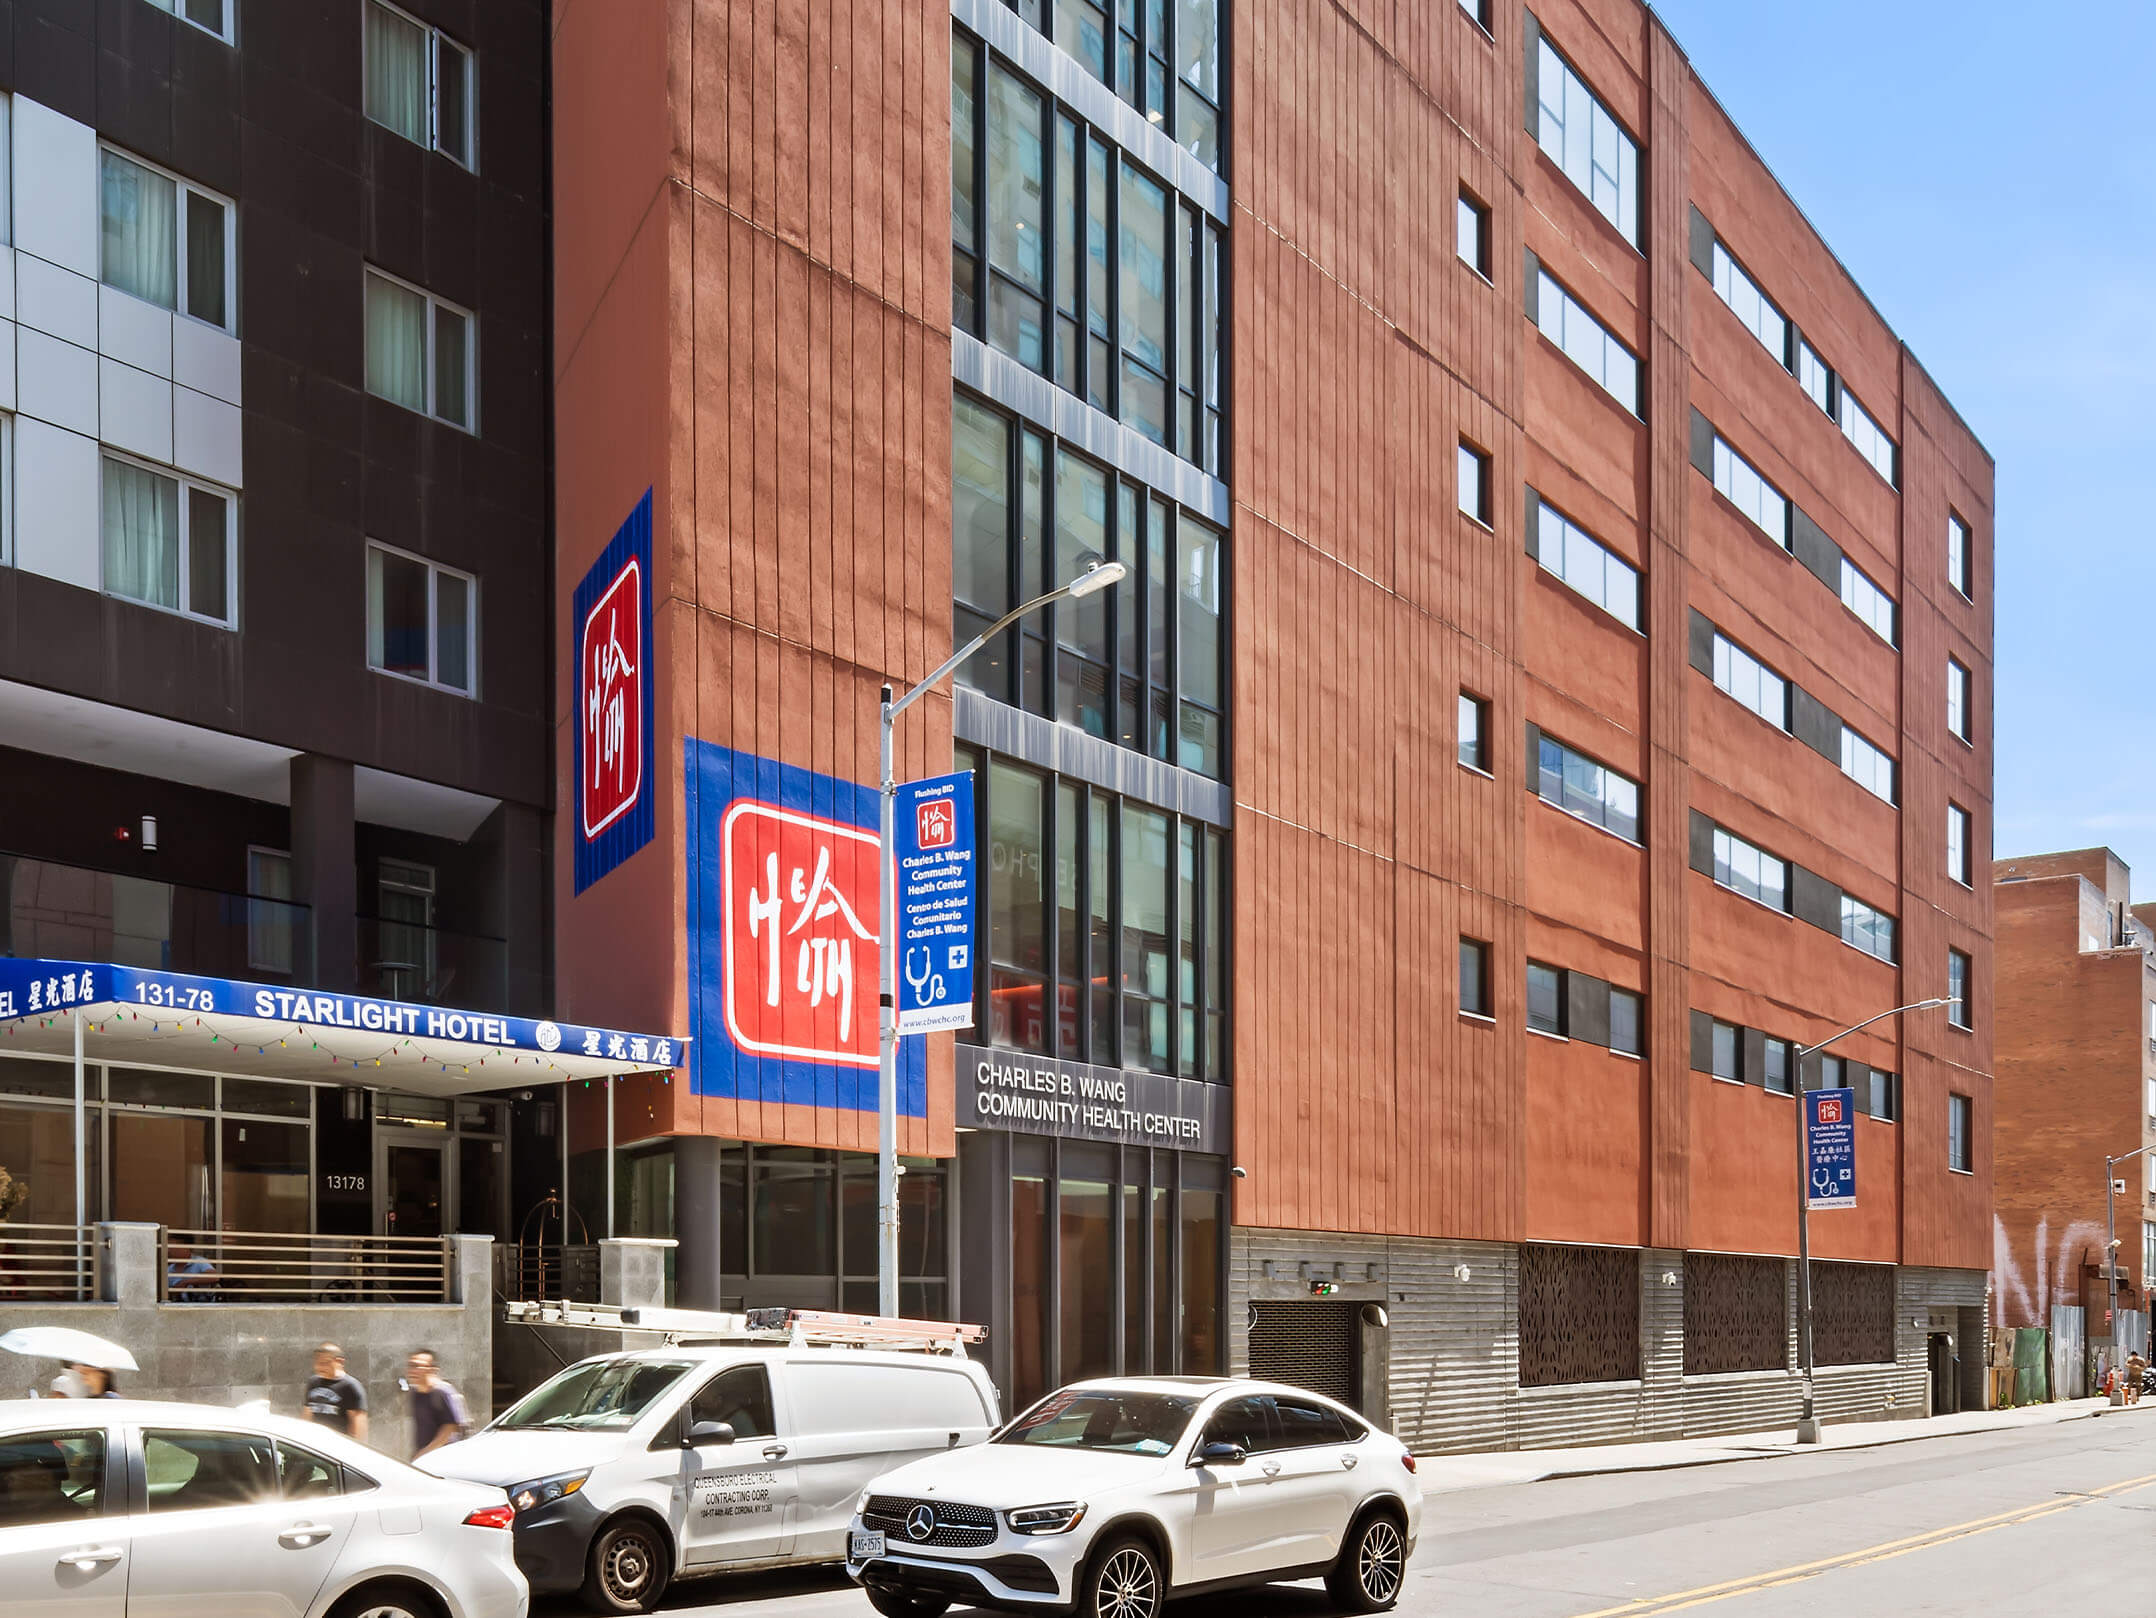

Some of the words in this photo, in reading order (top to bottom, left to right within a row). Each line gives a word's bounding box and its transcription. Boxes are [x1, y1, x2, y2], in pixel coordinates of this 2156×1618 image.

[902, 856, 934, 868] Charles
[935, 853, 944, 863] B.
[945, 850, 971, 861] Wang
[912, 865, 962, 881] Community
[907, 883, 935, 896] Health
[936, 879, 966, 891] Center
[906, 903, 931, 914] Centro
[932, 899, 943, 910] de
[944, 896, 968, 908] Salud
[912, 911, 962, 926] Comunitario
[906, 927, 934, 939] Charles
[935, 925, 944, 934] B.
[944, 923, 968, 934] Wang
[28, 969, 94, 1012] 星光酒店
[135, 981, 215, 1012] 131-78
[254, 990, 420, 1034] STARLIGHT
[427, 1011, 516, 1046] HOTEL
[582, 1030, 671, 1065] 星光酒店
[977, 1062, 1056, 1094] CHARLES
[1060, 1075, 1075, 1096] B.
[1079, 1077, 1126, 1103] WANG
[977, 1091, 1079, 1124] COMMUNITY
[1083, 1107, 1141, 1131] HEALTH
[1144, 1112, 1201, 1139] CENTER
[327, 1175, 365, 1190] 13178
[705, 1490, 750, 1505] CONTRACTING
[751, 1489, 770, 1501] CORP.
